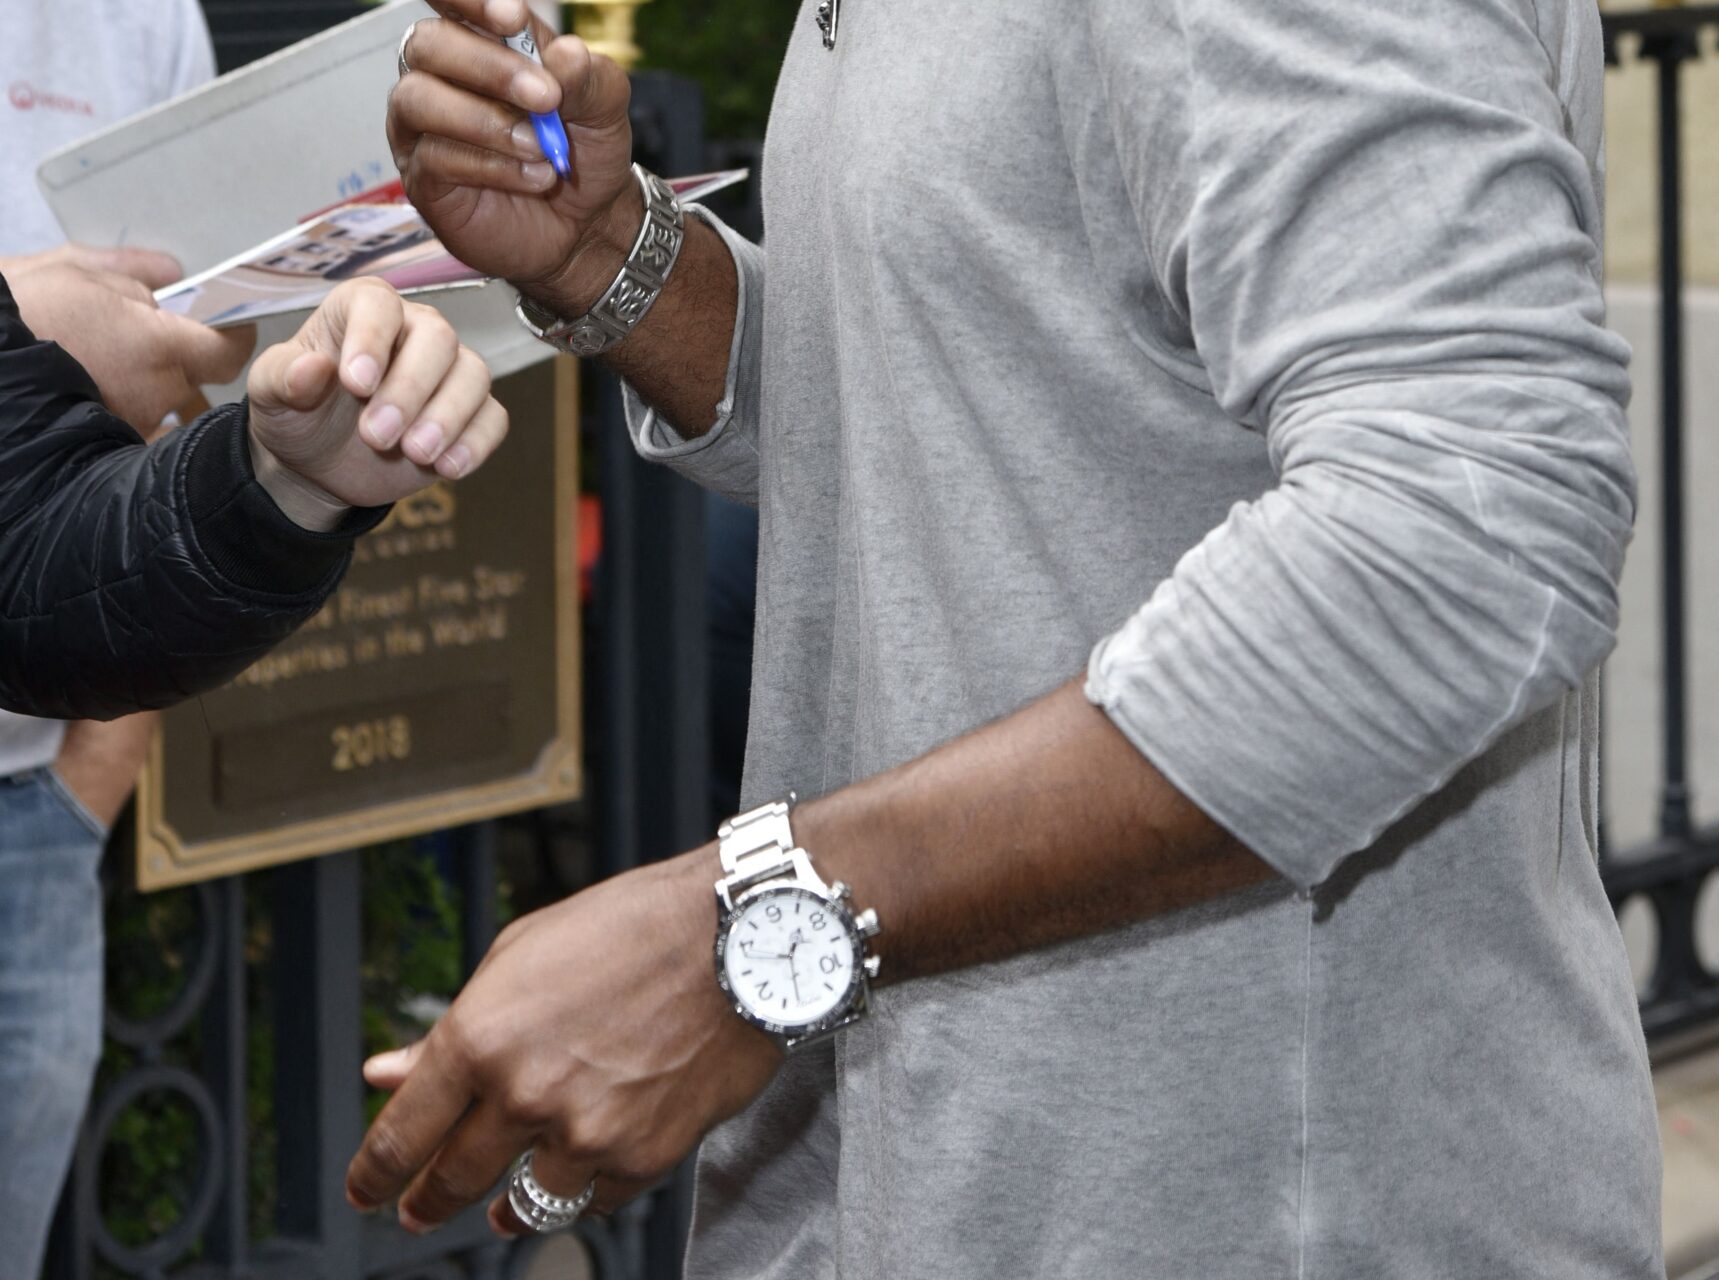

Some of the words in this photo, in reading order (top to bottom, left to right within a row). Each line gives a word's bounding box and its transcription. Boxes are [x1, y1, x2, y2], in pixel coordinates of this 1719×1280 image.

[354, 634, 380, 661] in
[384, 623, 425, 655] the
[809, 911, 826, 931] 8
[819, 952, 843, 974] 10
[754, 980, 774, 1001] 2
